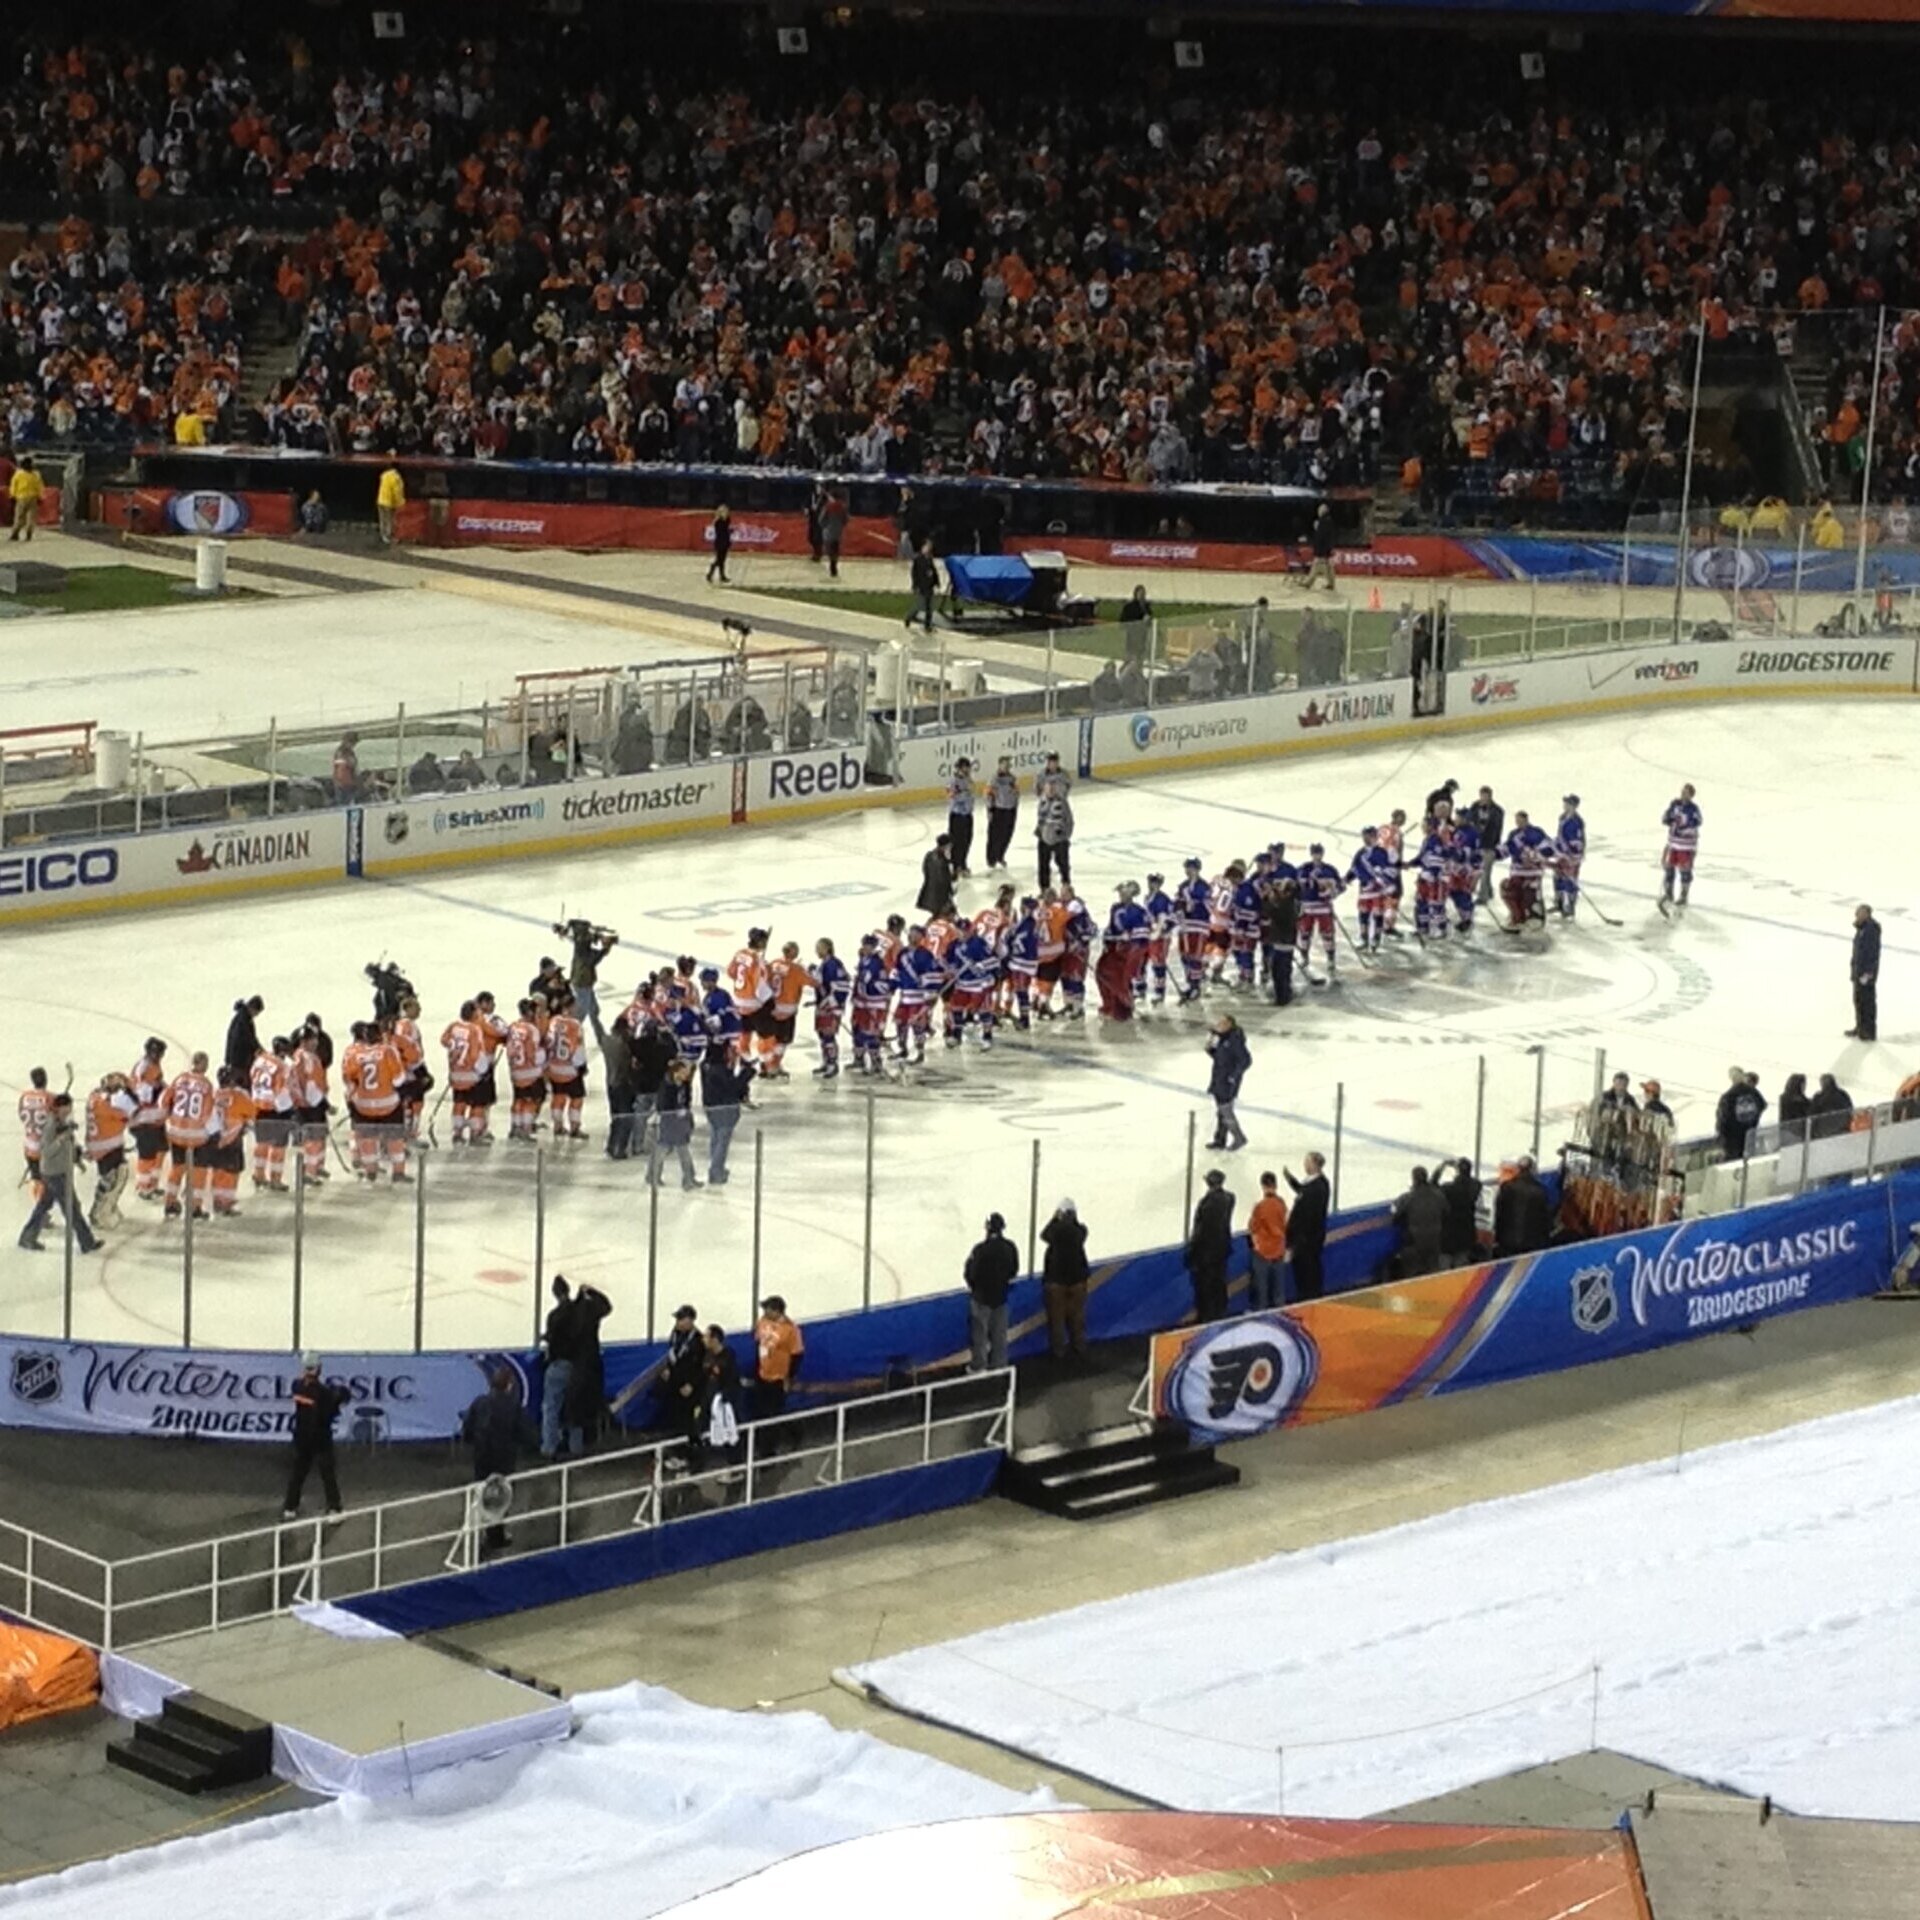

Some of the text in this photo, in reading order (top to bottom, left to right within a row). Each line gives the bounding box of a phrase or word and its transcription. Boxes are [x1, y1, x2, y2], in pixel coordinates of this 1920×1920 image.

[1737, 650, 1895, 674] BRIDGESTONE
[561, 782, 707, 822] ticketmaster
[211, 829, 311, 871] CANADIAN
[363, 1063, 380, 1090] 2
[173, 1092, 206, 1119] 28
[1687, 1273, 1812, 1328] BRIDGESTONE
[150, 1404, 338, 1434] BRIDGEST
